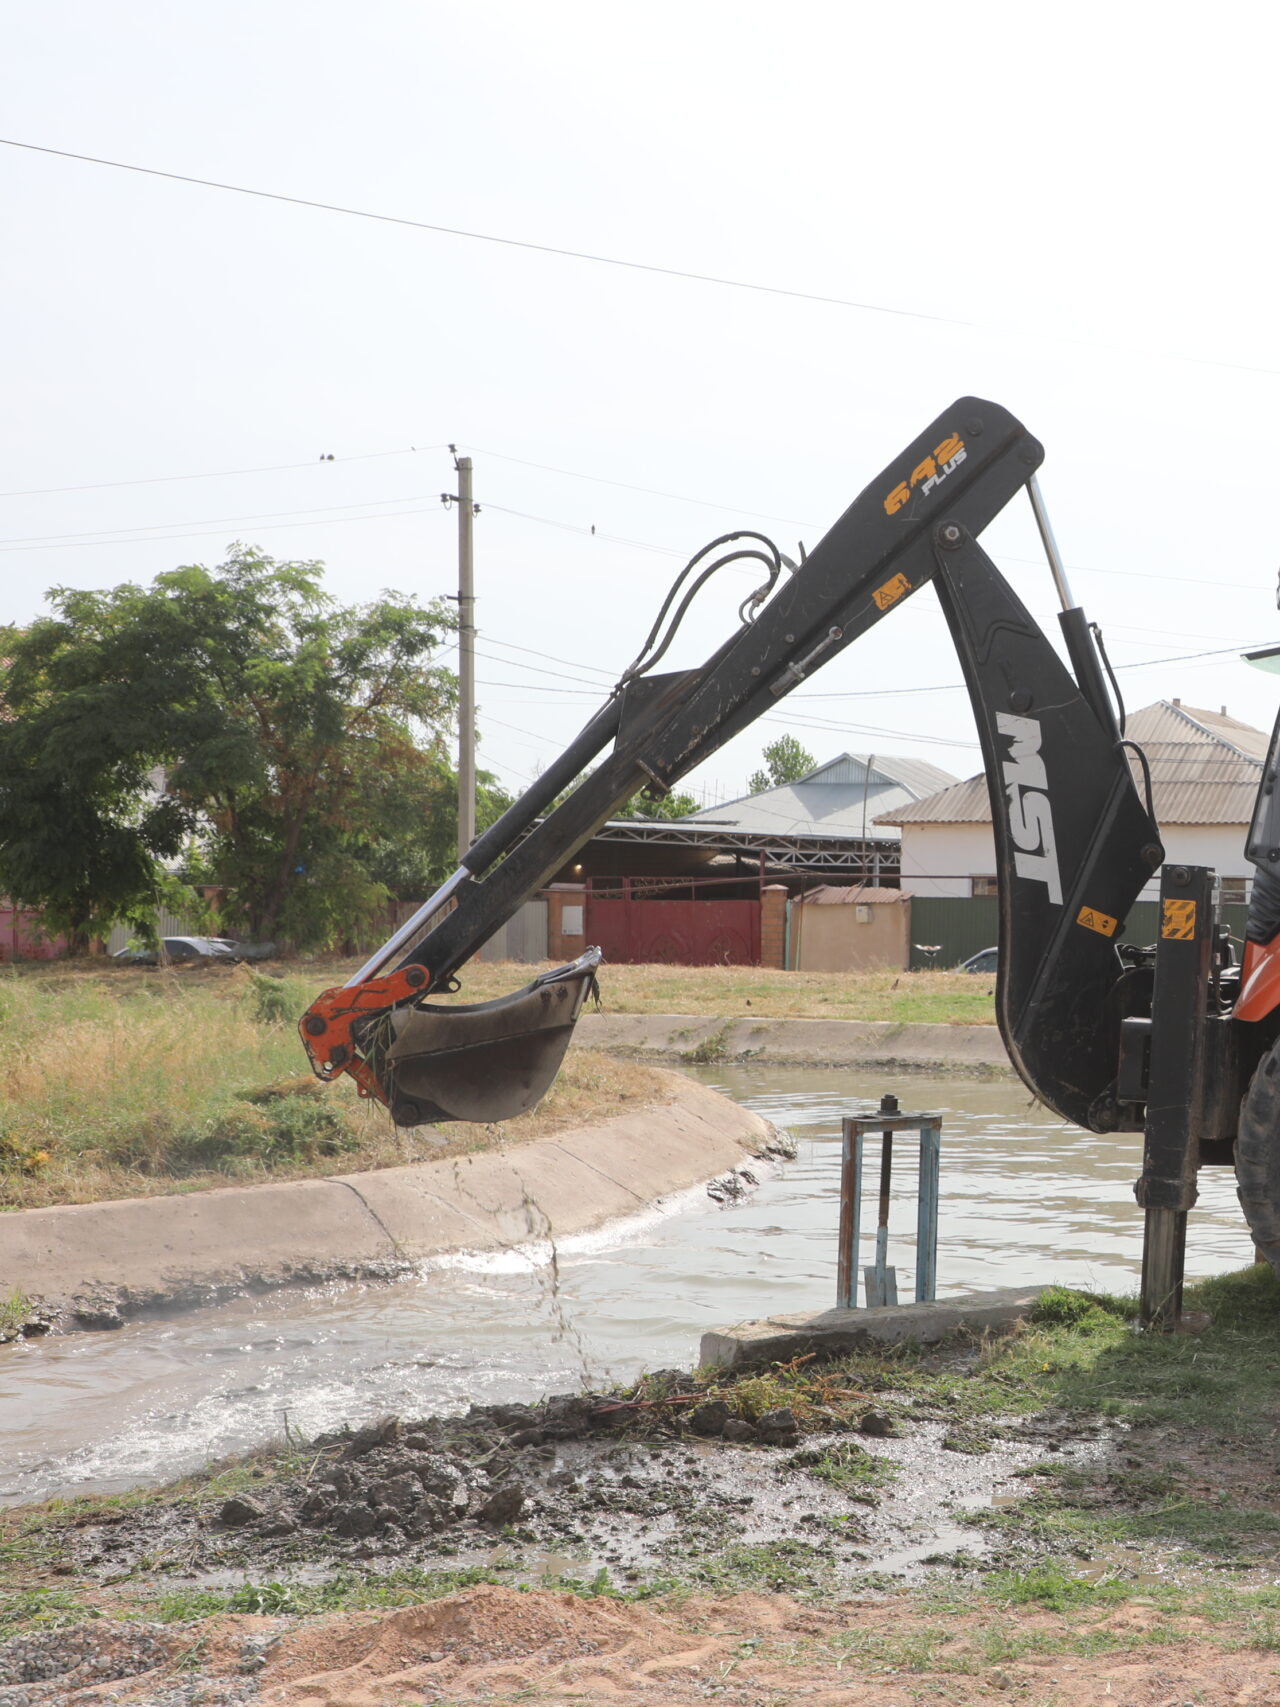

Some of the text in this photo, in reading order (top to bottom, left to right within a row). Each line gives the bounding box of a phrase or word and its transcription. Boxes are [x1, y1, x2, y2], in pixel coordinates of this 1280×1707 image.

[883, 431, 965, 515] 642
[921, 447, 967, 496] PLUS
[995, 711, 1064, 906] MST
